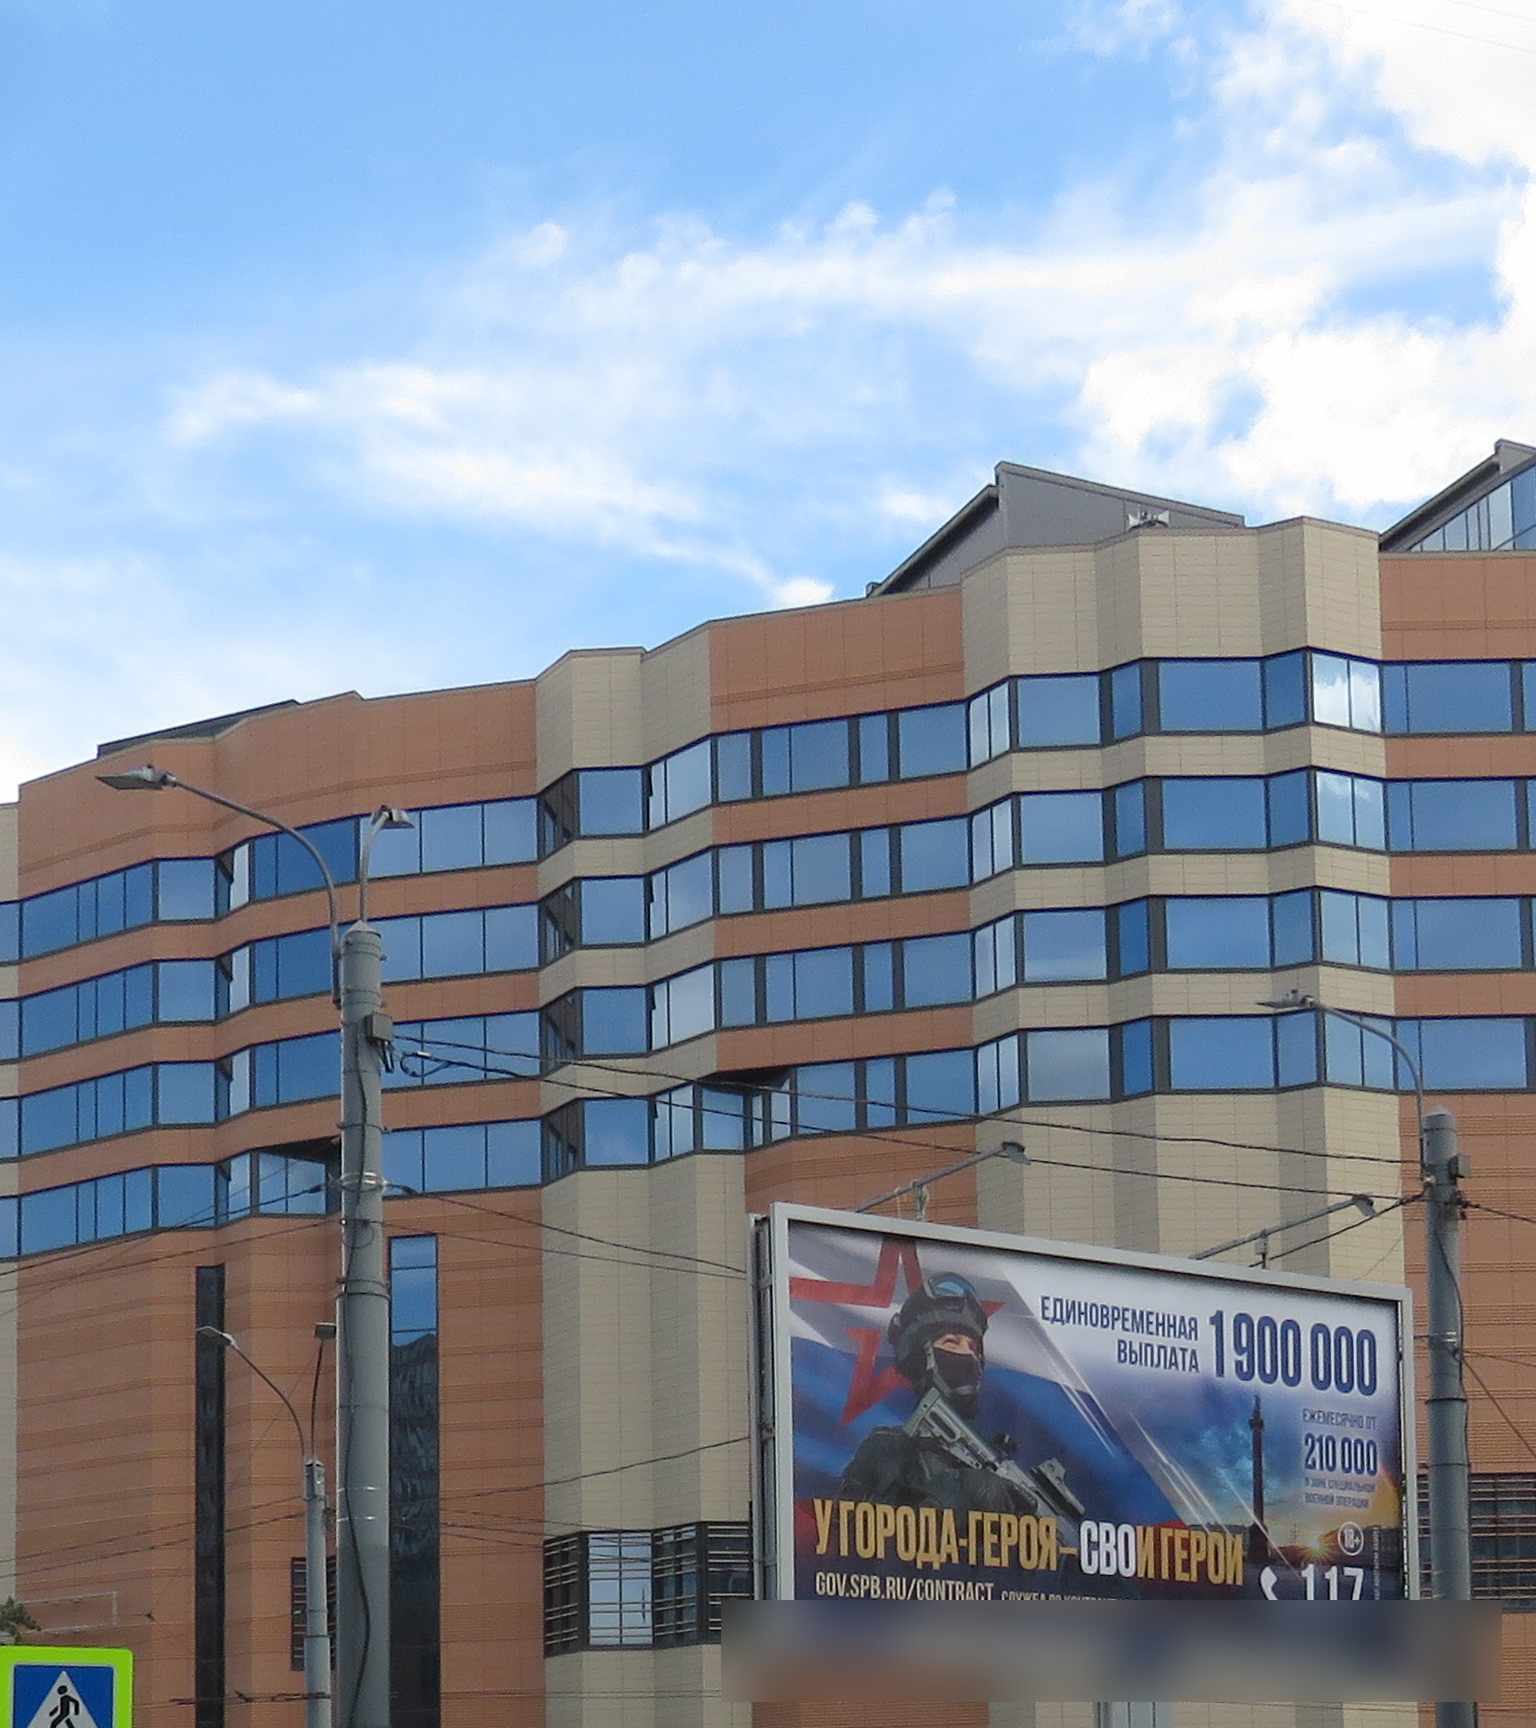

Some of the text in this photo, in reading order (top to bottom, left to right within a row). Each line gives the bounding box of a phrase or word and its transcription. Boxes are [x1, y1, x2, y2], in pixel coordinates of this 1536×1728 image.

[1040, 1296, 1199, 1341] ЕДИНОВРЕМЕННАЯ
[1117, 1339, 1200, 1373] ВЫПЛАТА
[1304, 1432, 1377, 1476] 210 000
[814, 1499, 832, 1555] У
[839, 1501, 1057, 1571] ГОРОДА-ГЕРОЯ
[1080, 1520, 1155, 1579] СВОИ
[1161, 1527, 1243, 1585] ГЕРОИ
[816, 1571, 994, 1600] GOV.SPB.RU/CONTRACT
[1301, 1563, 1364, 1600] 117
